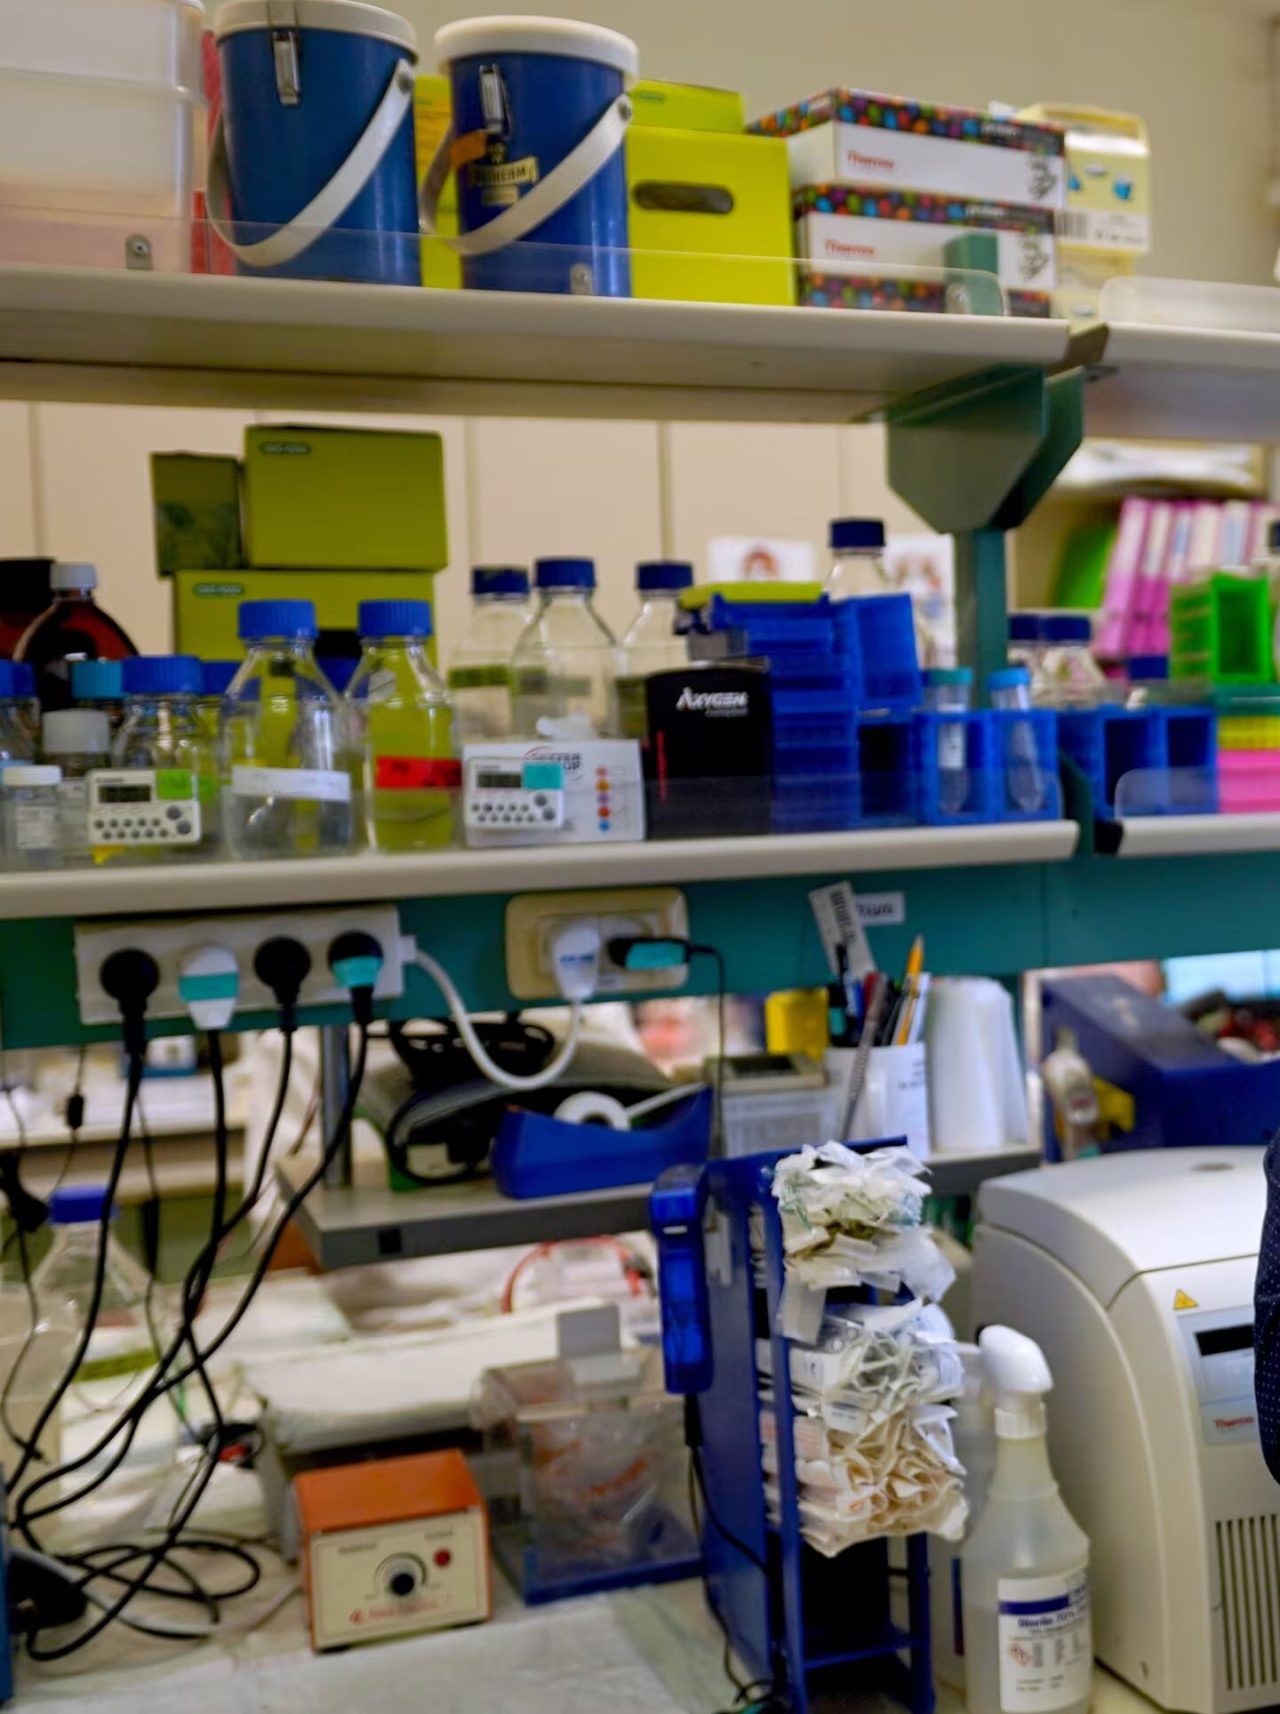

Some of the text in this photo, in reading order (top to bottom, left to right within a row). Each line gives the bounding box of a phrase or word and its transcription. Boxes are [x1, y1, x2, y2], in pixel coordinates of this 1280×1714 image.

[847, 150, 895, 170] Thermo
[824, 239, 876, 257] Thermo
[1213, 1416, 1256, 1429] Thermo
